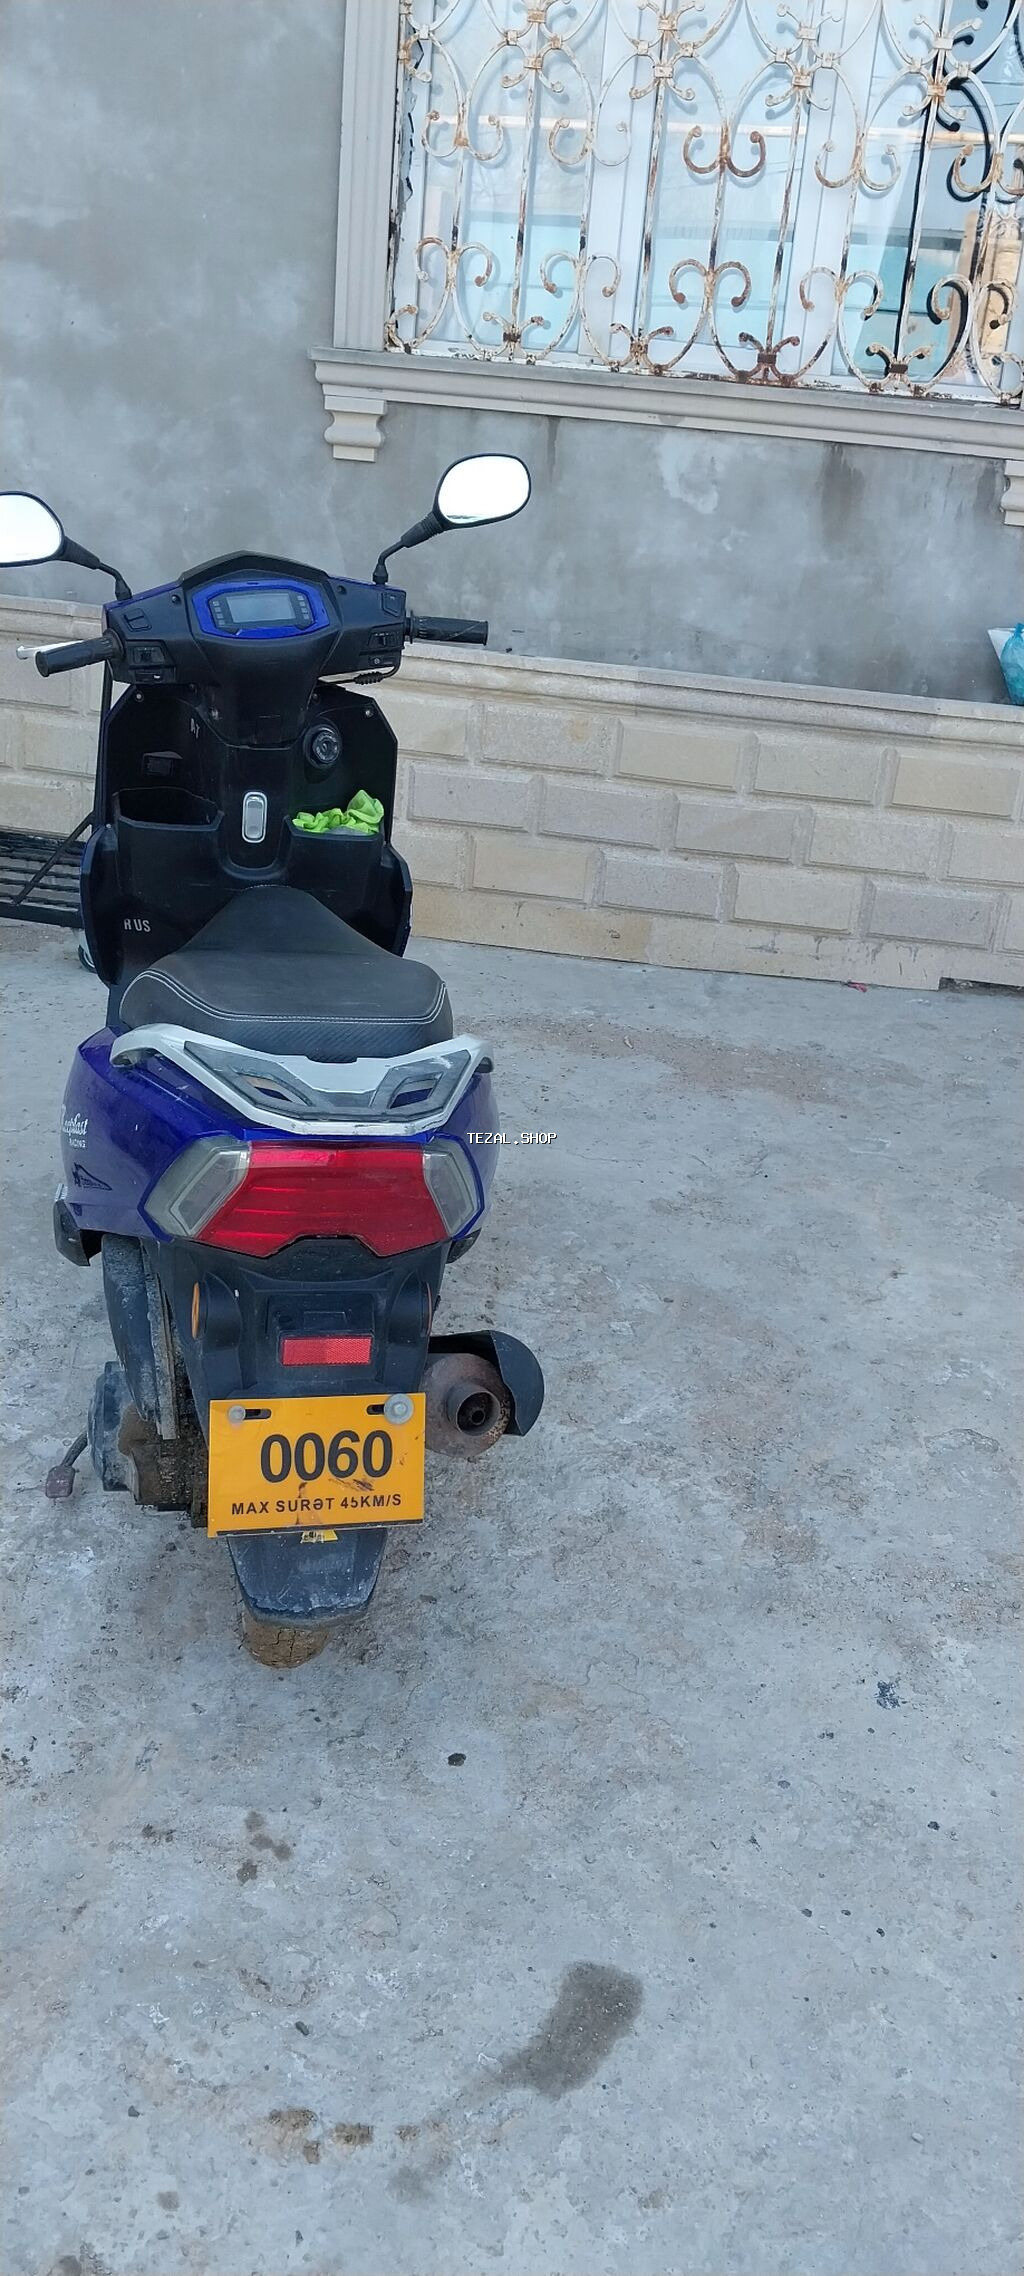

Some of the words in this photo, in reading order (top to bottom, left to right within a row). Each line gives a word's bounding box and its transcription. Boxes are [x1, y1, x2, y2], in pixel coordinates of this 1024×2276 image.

[260, 1429, 393, 1483] 0060
[231, 1501, 270, 1515] MAX
[340, 1493, 402, 1509] 45KM/S
